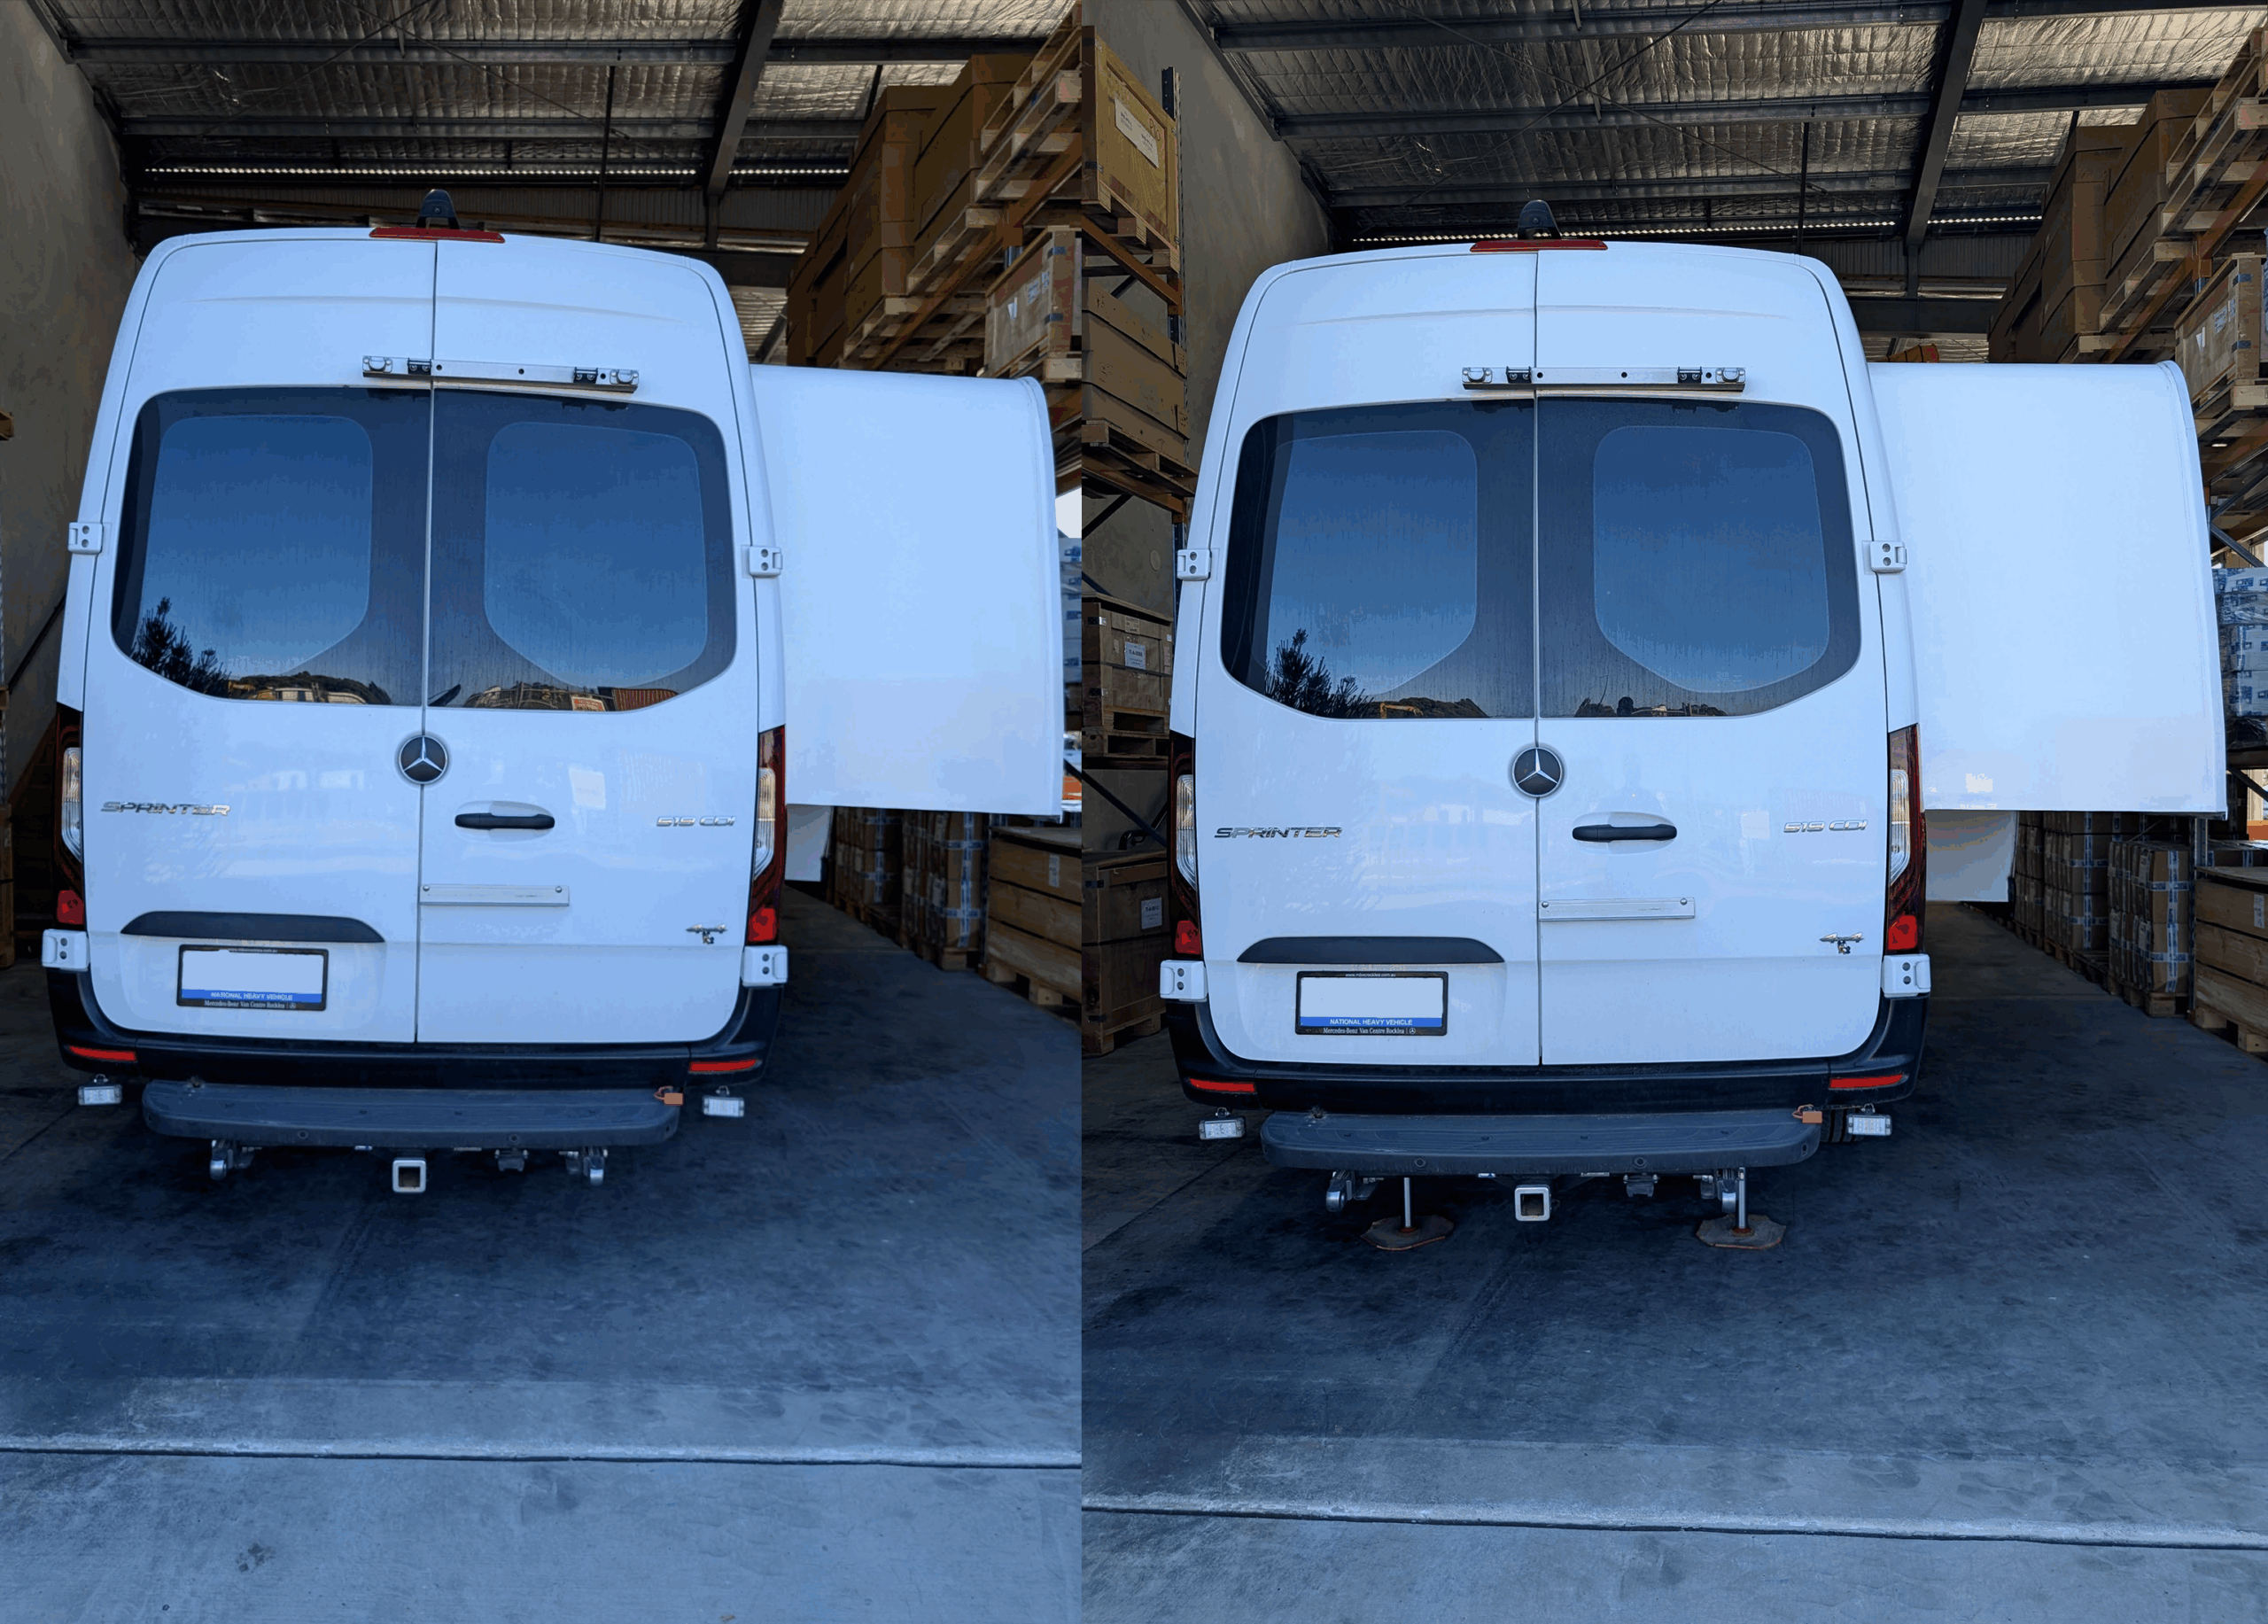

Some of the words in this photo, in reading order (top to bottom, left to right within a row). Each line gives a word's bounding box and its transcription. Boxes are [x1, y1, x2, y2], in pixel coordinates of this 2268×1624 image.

[101, 801, 230, 816] SPRINTER
[656, 816, 695, 827] 519
[1783, 821, 1825, 833] 519
[1214, 827, 1343, 838] SPRINTER
